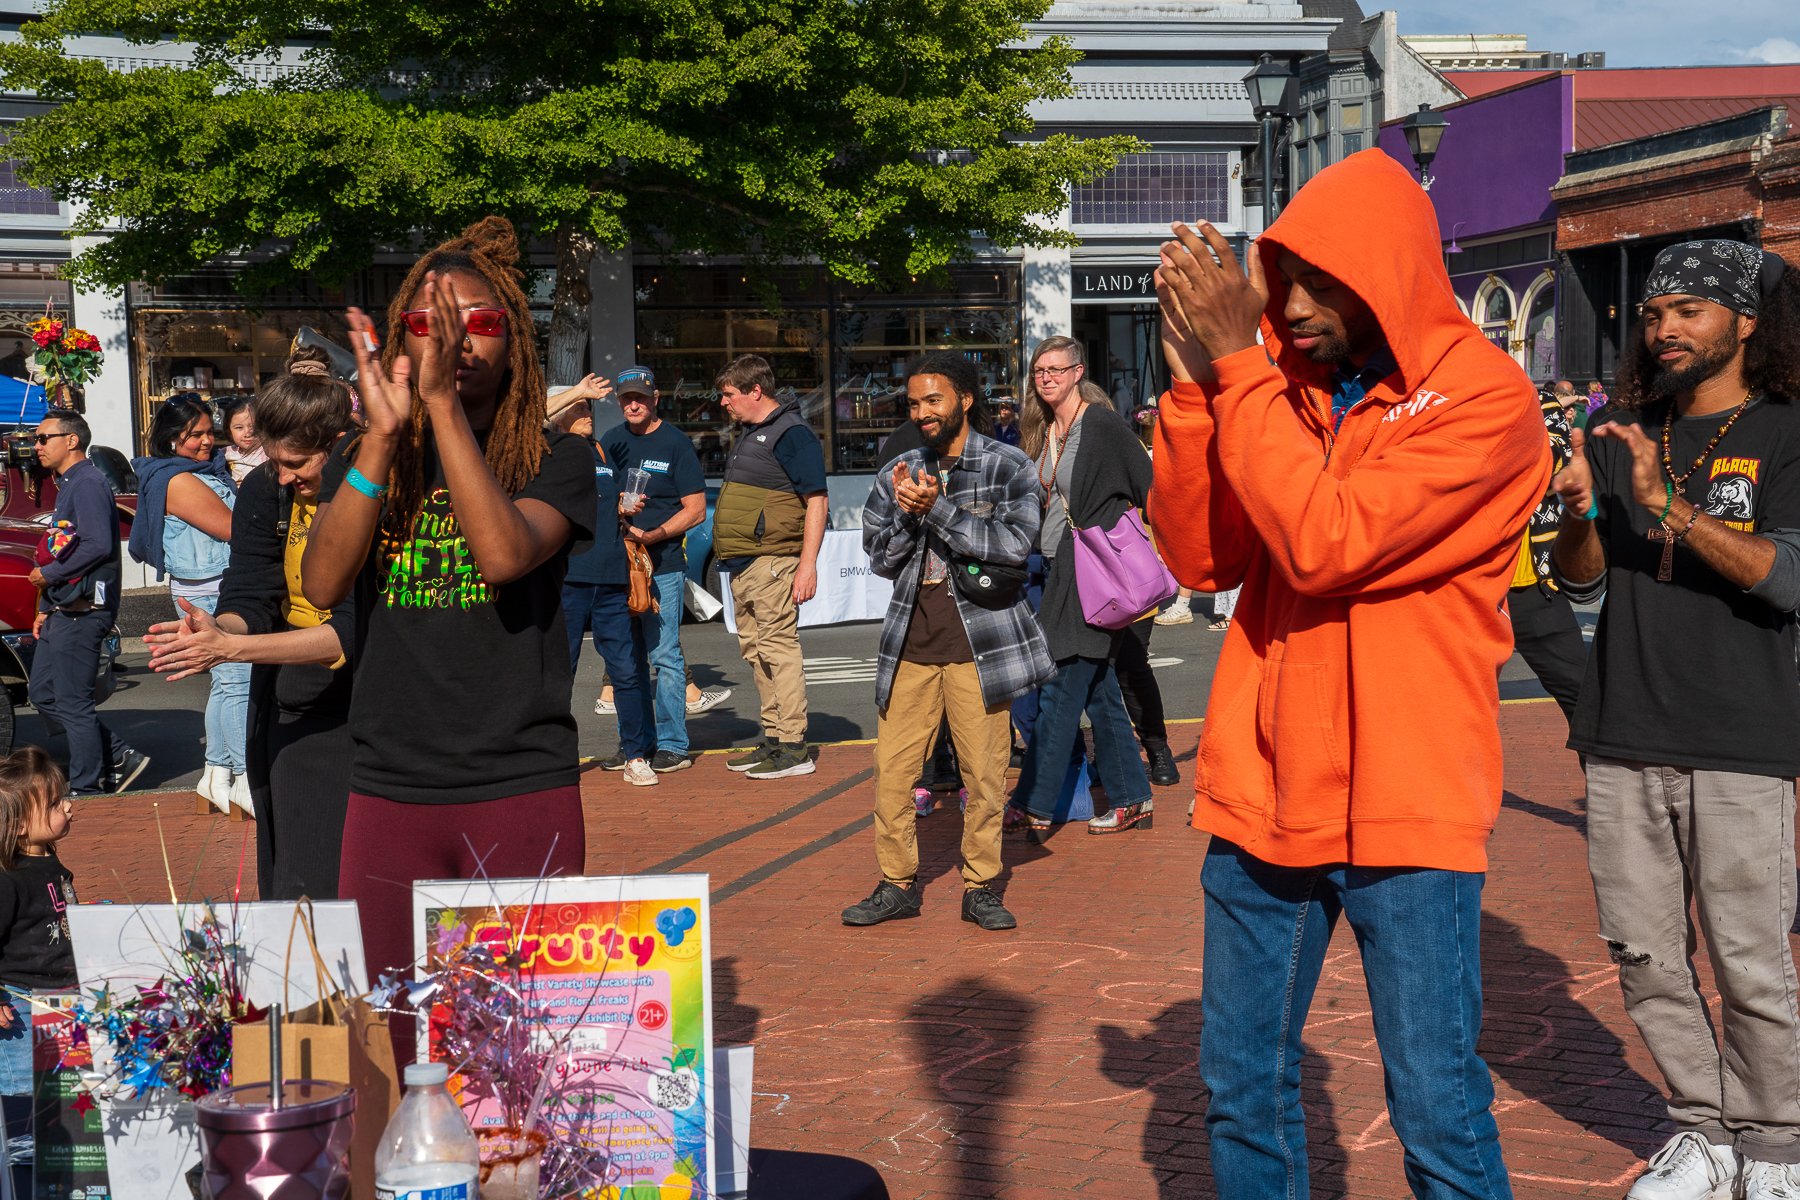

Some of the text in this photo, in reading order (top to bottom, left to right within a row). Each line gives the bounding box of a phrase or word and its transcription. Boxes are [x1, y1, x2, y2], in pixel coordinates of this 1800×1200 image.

[1085, 272, 1152, 294] LAND of
[643, 459, 670, 469] AUTISM
[1708, 457, 1761, 485] BLACK
[376, 536, 478, 578] GIFTE
[840, 566, 866, 578] BMW
[470, 921, 656, 968] Fruity
[547, 978, 583, 992] Variety
[631, 976, 654, 987] with
[549, 998, 567, 1009] and
[598, 995, 629, 1006] Freaks
[585, 1011, 618, 1024] Exhibit
[620, 1011, 634, 1024] by
[640, 1008, 664, 1024] 21+
[572, 1060, 612, 1074] June
[620, 1110, 631, 1119] at
[623, 1124, 647, 1136] going
[611, 1149, 669, 1161] how at 9pm
[620, 1165, 655, 1177] Eureka
